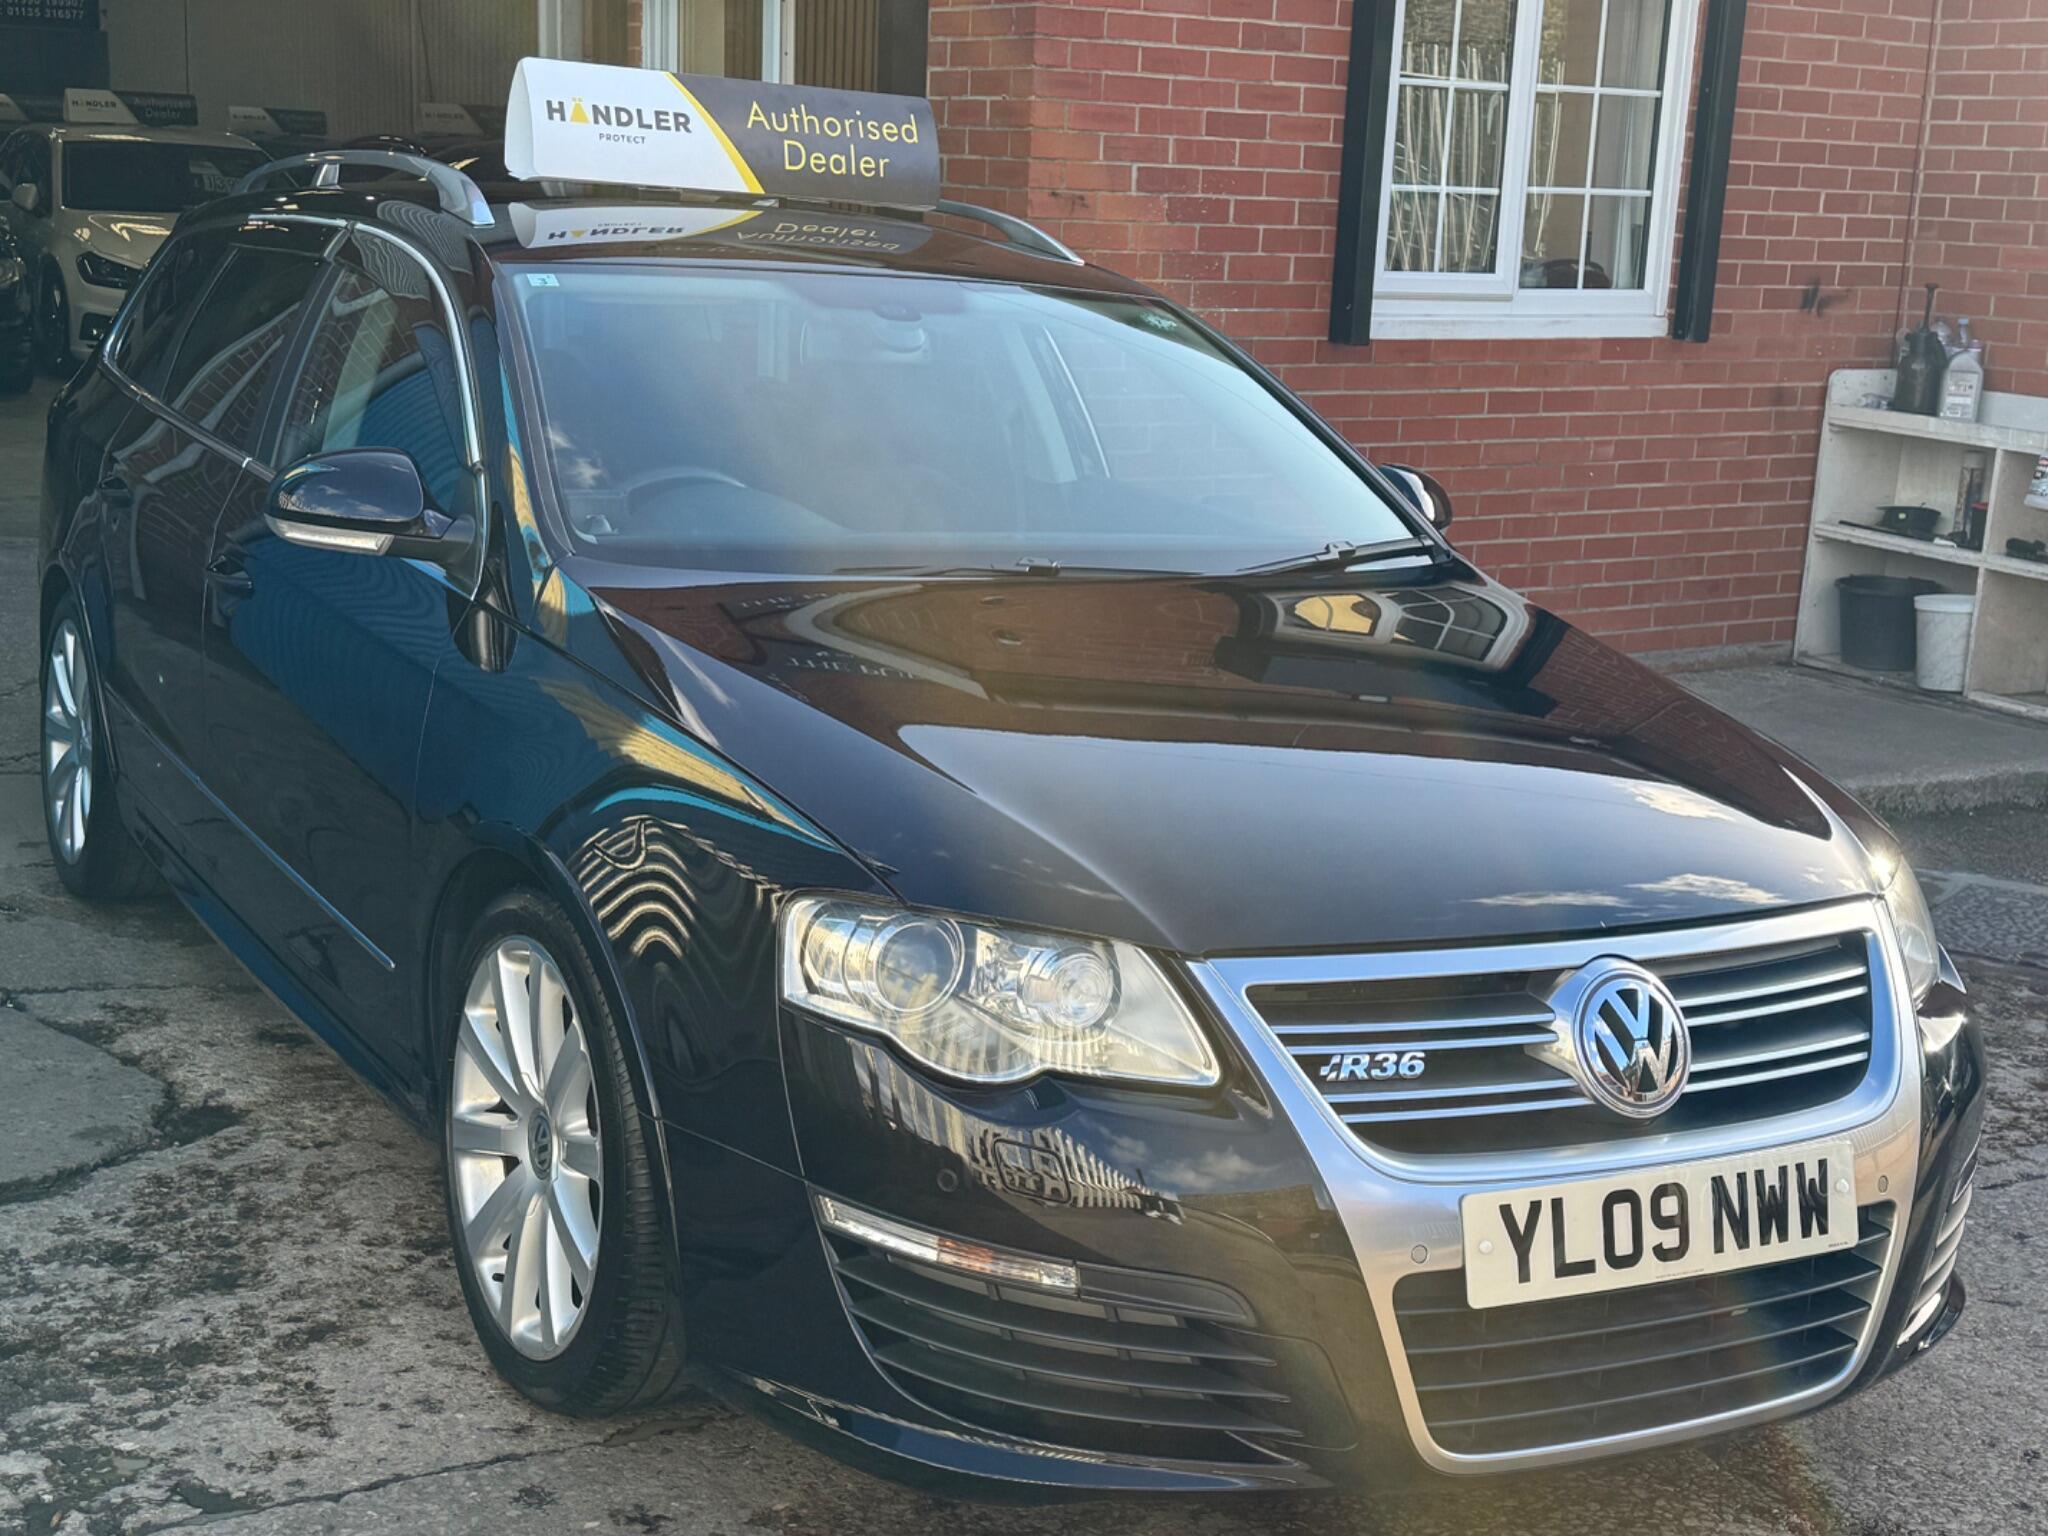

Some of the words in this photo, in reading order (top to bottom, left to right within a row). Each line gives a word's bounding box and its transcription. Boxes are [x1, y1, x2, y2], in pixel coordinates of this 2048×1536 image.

[598, 132, 647, 145] PROTECT
[746, 100, 919, 144] Authorised
[783, 139, 890, 178] Dealer
[1498, 1181, 1691, 1285] YL09
[1710, 1157, 1830, 1255] NWW
